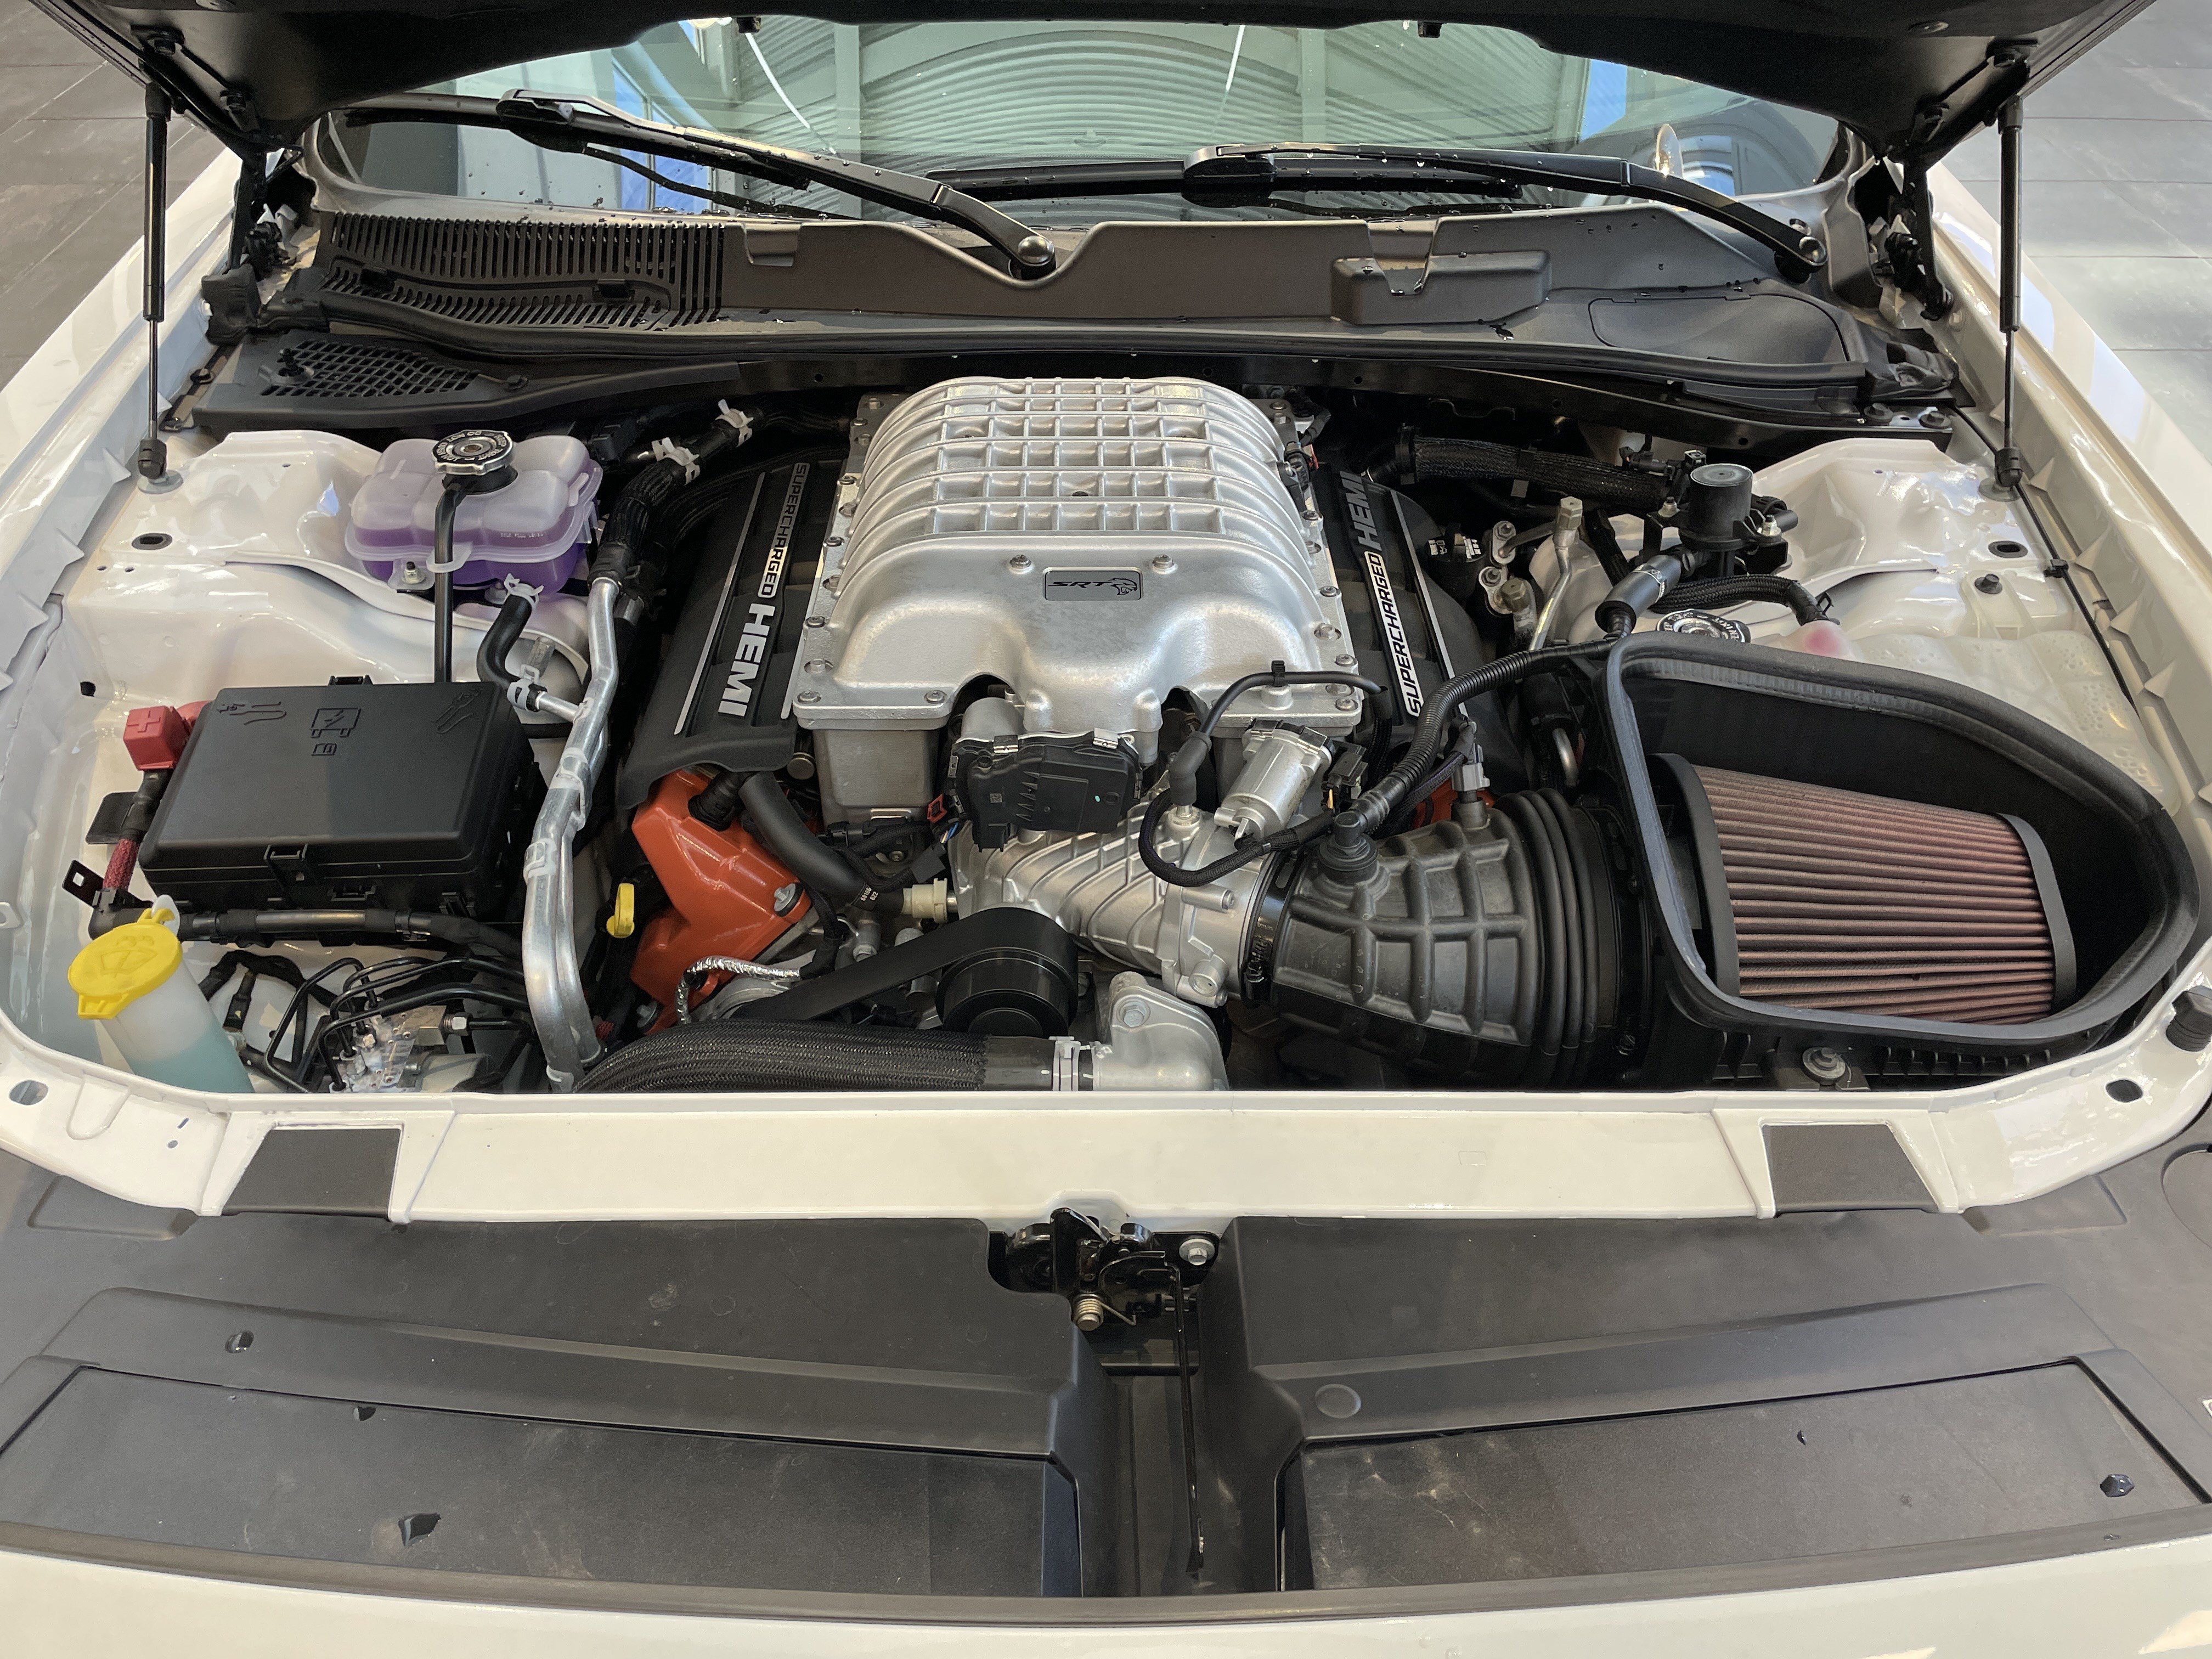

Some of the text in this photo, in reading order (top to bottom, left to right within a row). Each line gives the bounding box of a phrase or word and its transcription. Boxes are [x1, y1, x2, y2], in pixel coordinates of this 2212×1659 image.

[718, 464, 807, 716] SUPERCHARGED HEMI
[1340, 471, 1422, 714] SUPERCHARGED HEMI
[870, 891, 878, 901] 622
